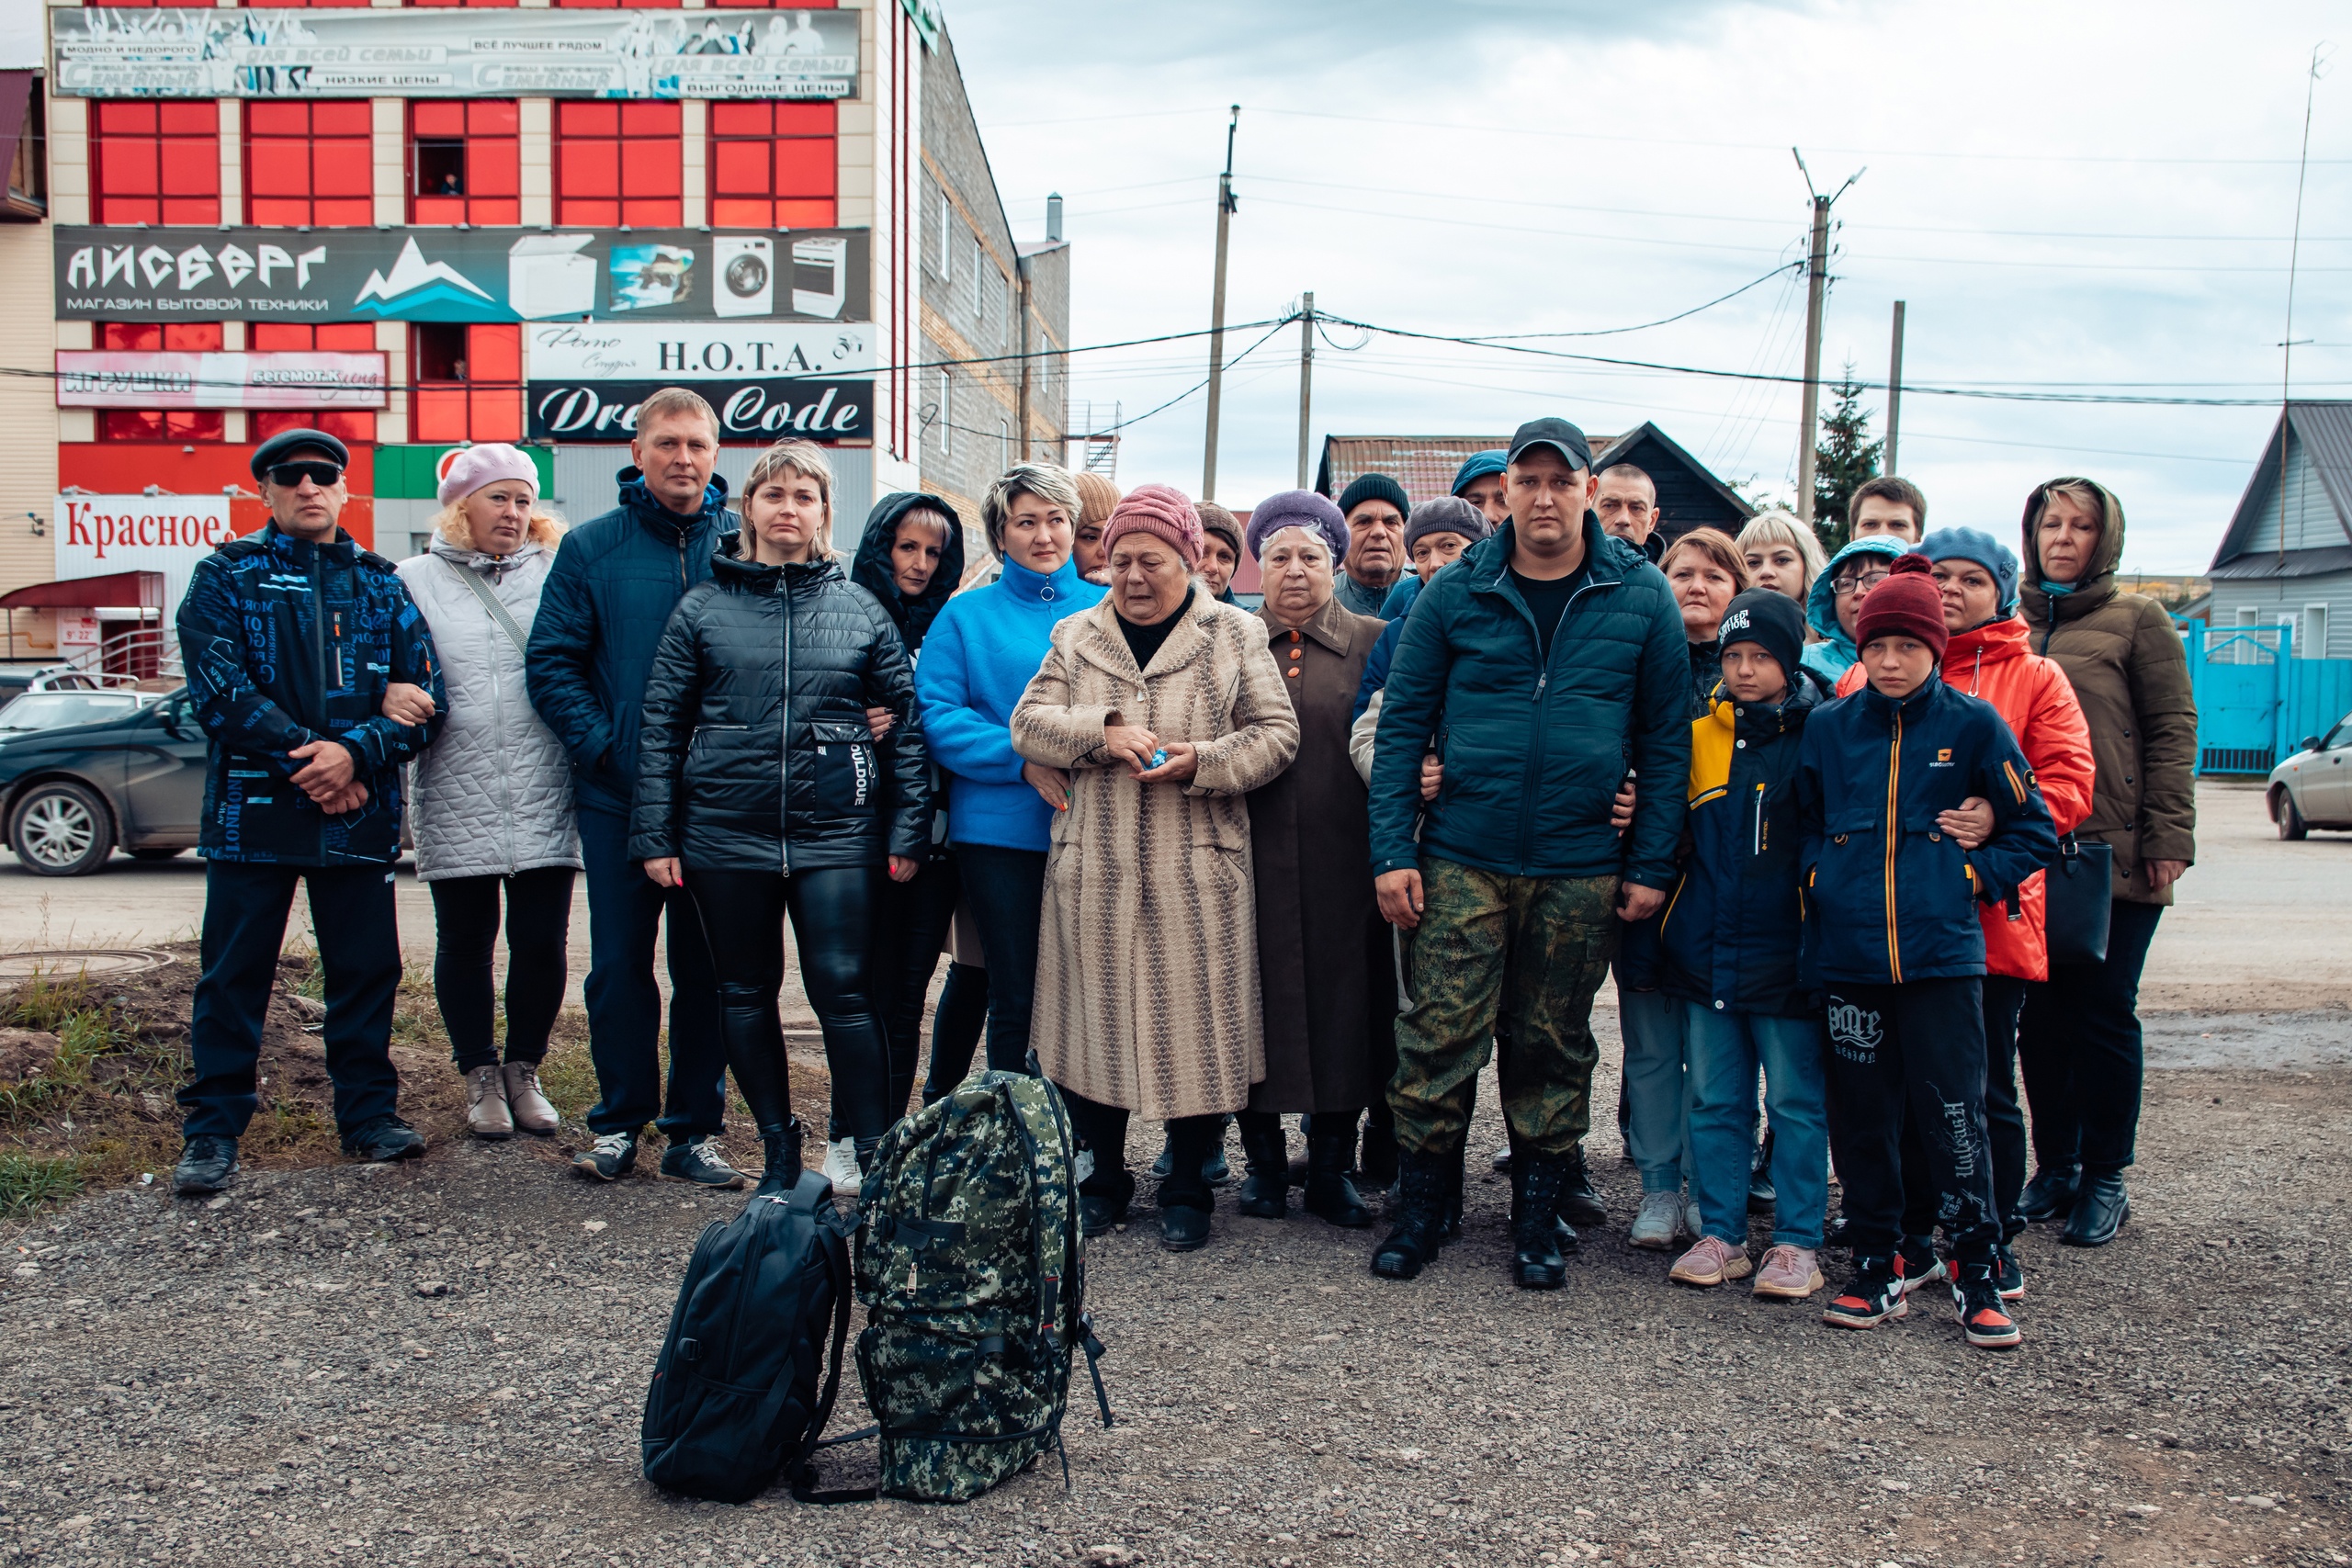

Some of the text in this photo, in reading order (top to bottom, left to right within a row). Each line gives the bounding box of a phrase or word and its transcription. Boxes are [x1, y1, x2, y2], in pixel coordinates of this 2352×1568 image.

[67, 46, 112, 54] МОДНО
[325, 76, 439, 85] НИЗКИЕ ЦЕНЫ
[687, 84, 844, 93] ВЫГОДНЫЕ ЦЕНЫ
[66, 297, 329, 310] МАГАЗИН БЫТОВОЙ ТЕХНИКИ
[538, 386, 860, 432] Dre Code
[65, 502, 220, 558] Красное
